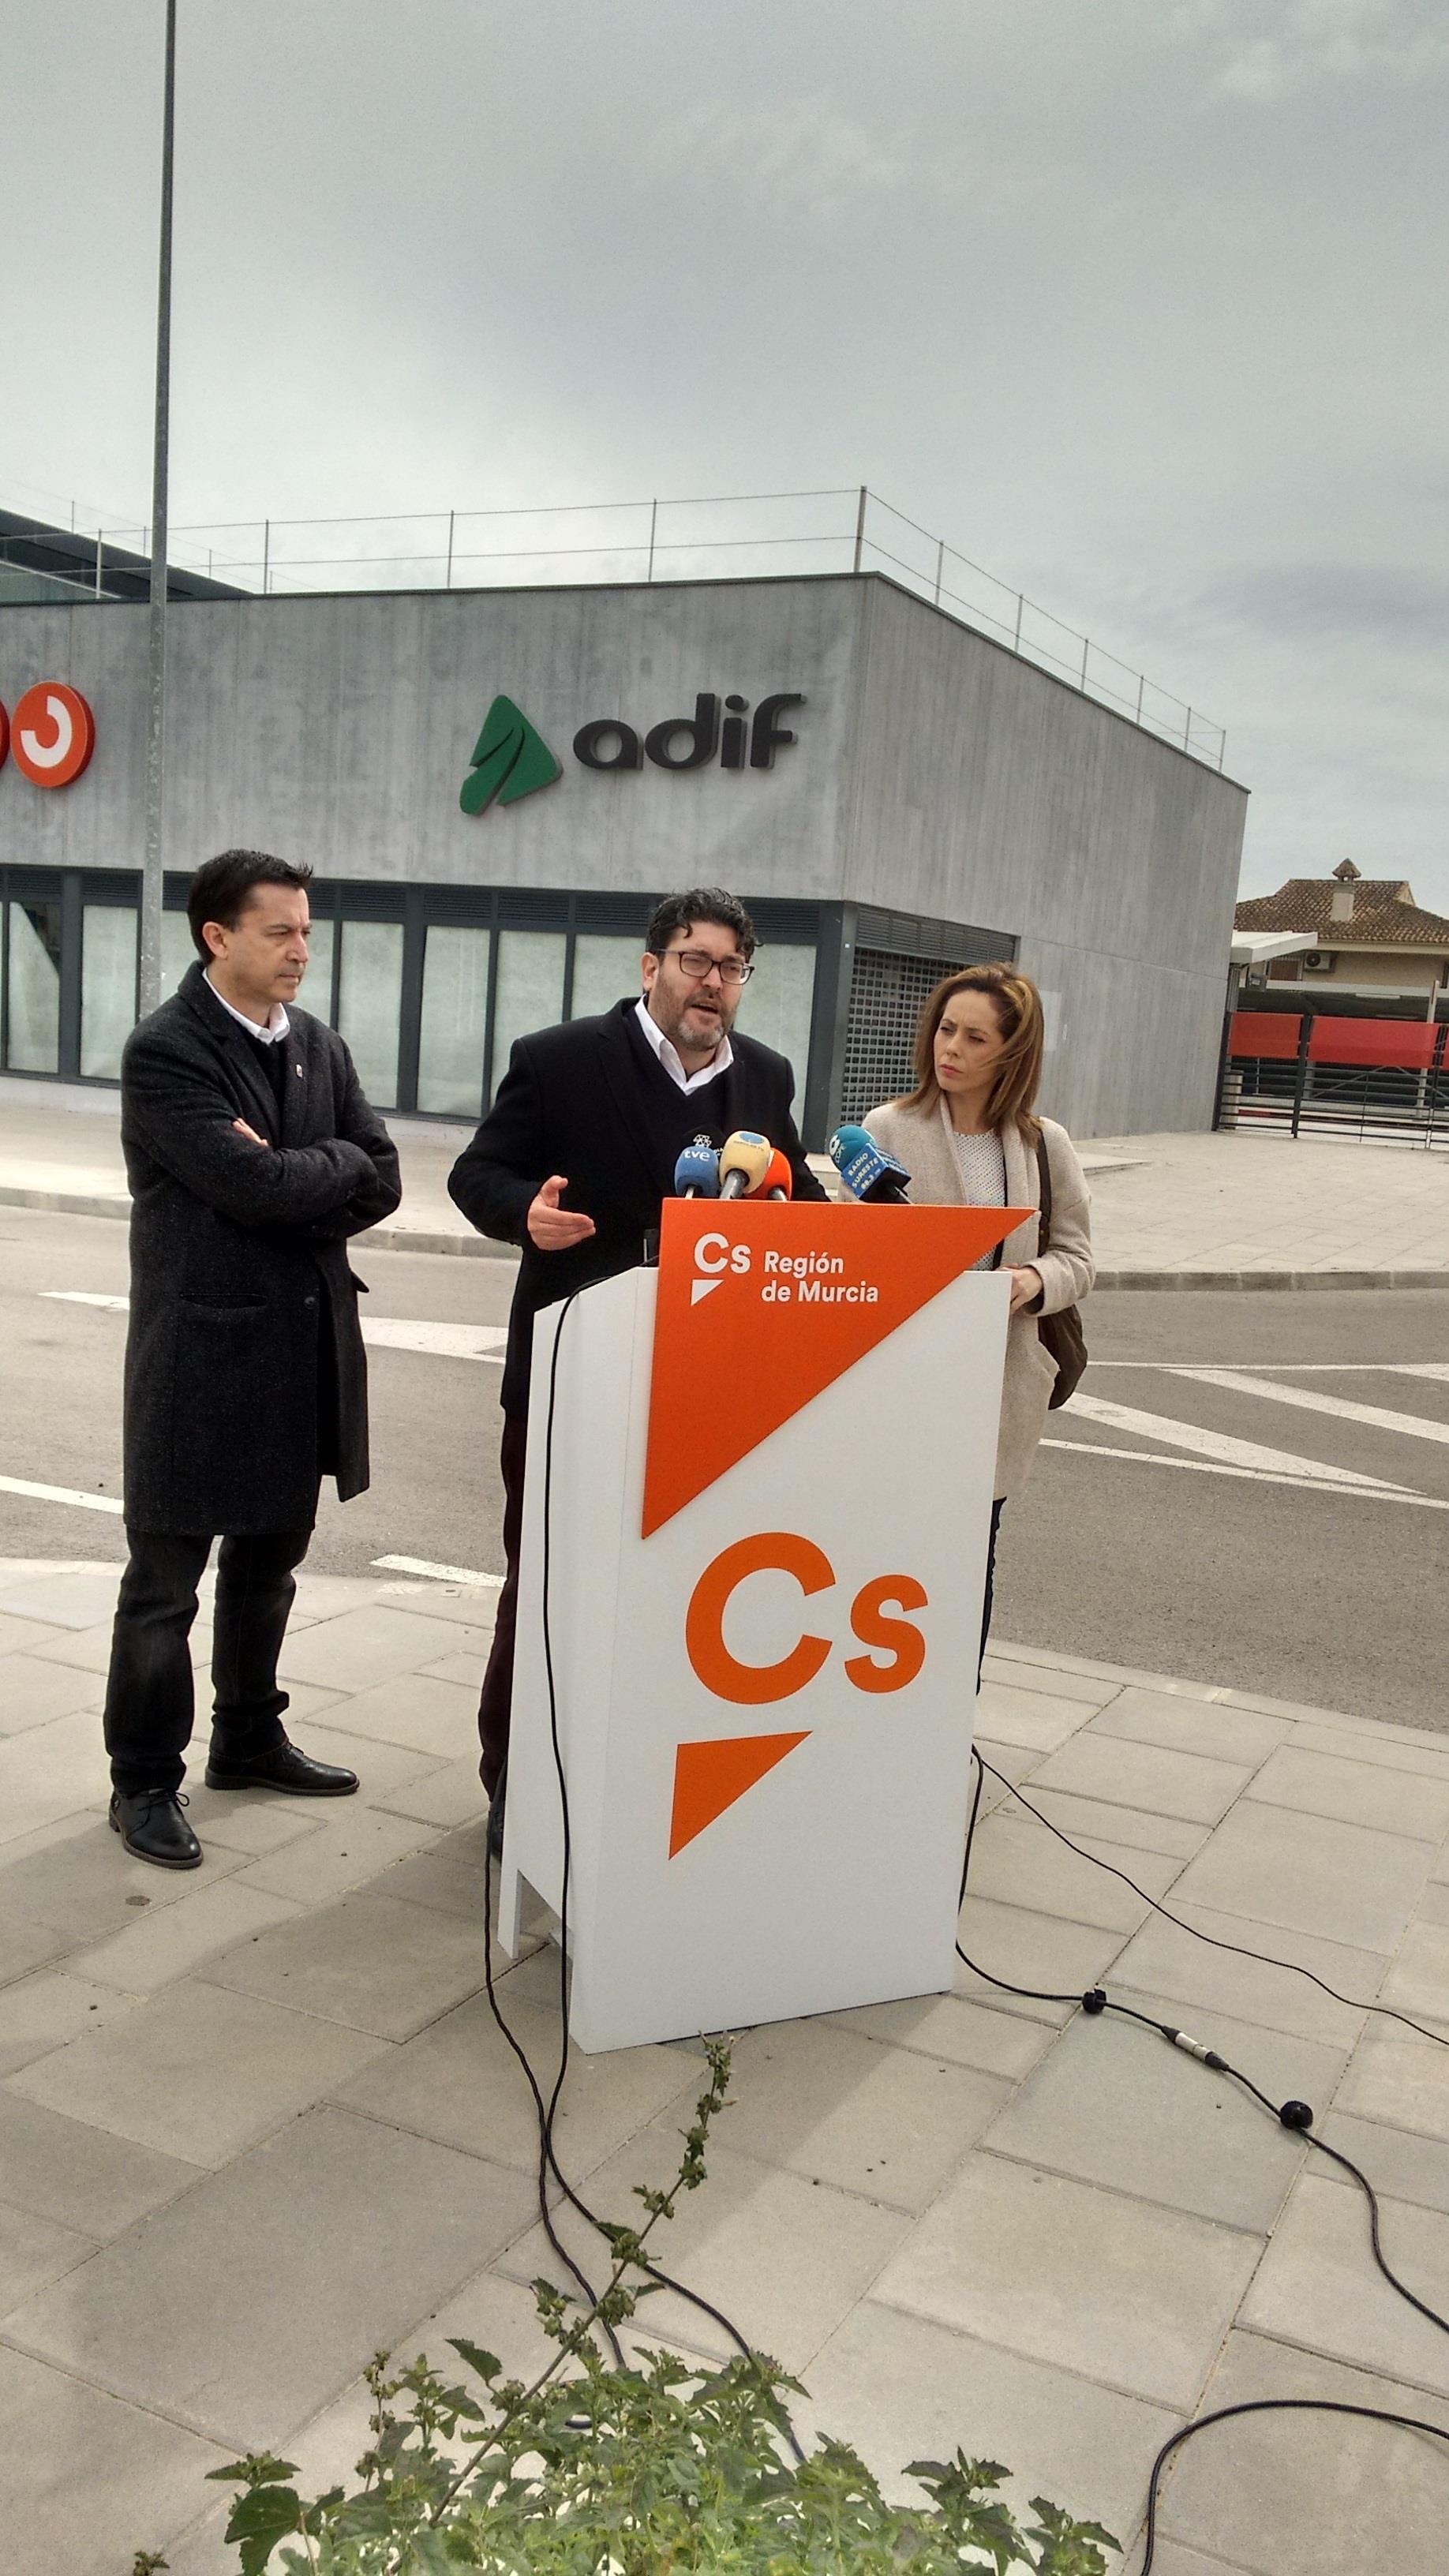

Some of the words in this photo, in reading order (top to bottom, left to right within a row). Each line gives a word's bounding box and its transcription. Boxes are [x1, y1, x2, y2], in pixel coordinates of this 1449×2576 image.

[573, 692, 807, 770] adif
[683, 1150, 710, 1162] tve
[848, 1152, 869, 1177] RADIO
[852, 1157, 879, 1189] SURESTE
[694, 1232, 751, 1274] Cs
[763, 1250, 844, 1279] Región
[761, 1279, 791, 1302] de
[798, 1280, 879, 1303] Murcia
[685, 1531, 929, 1705] Cs
